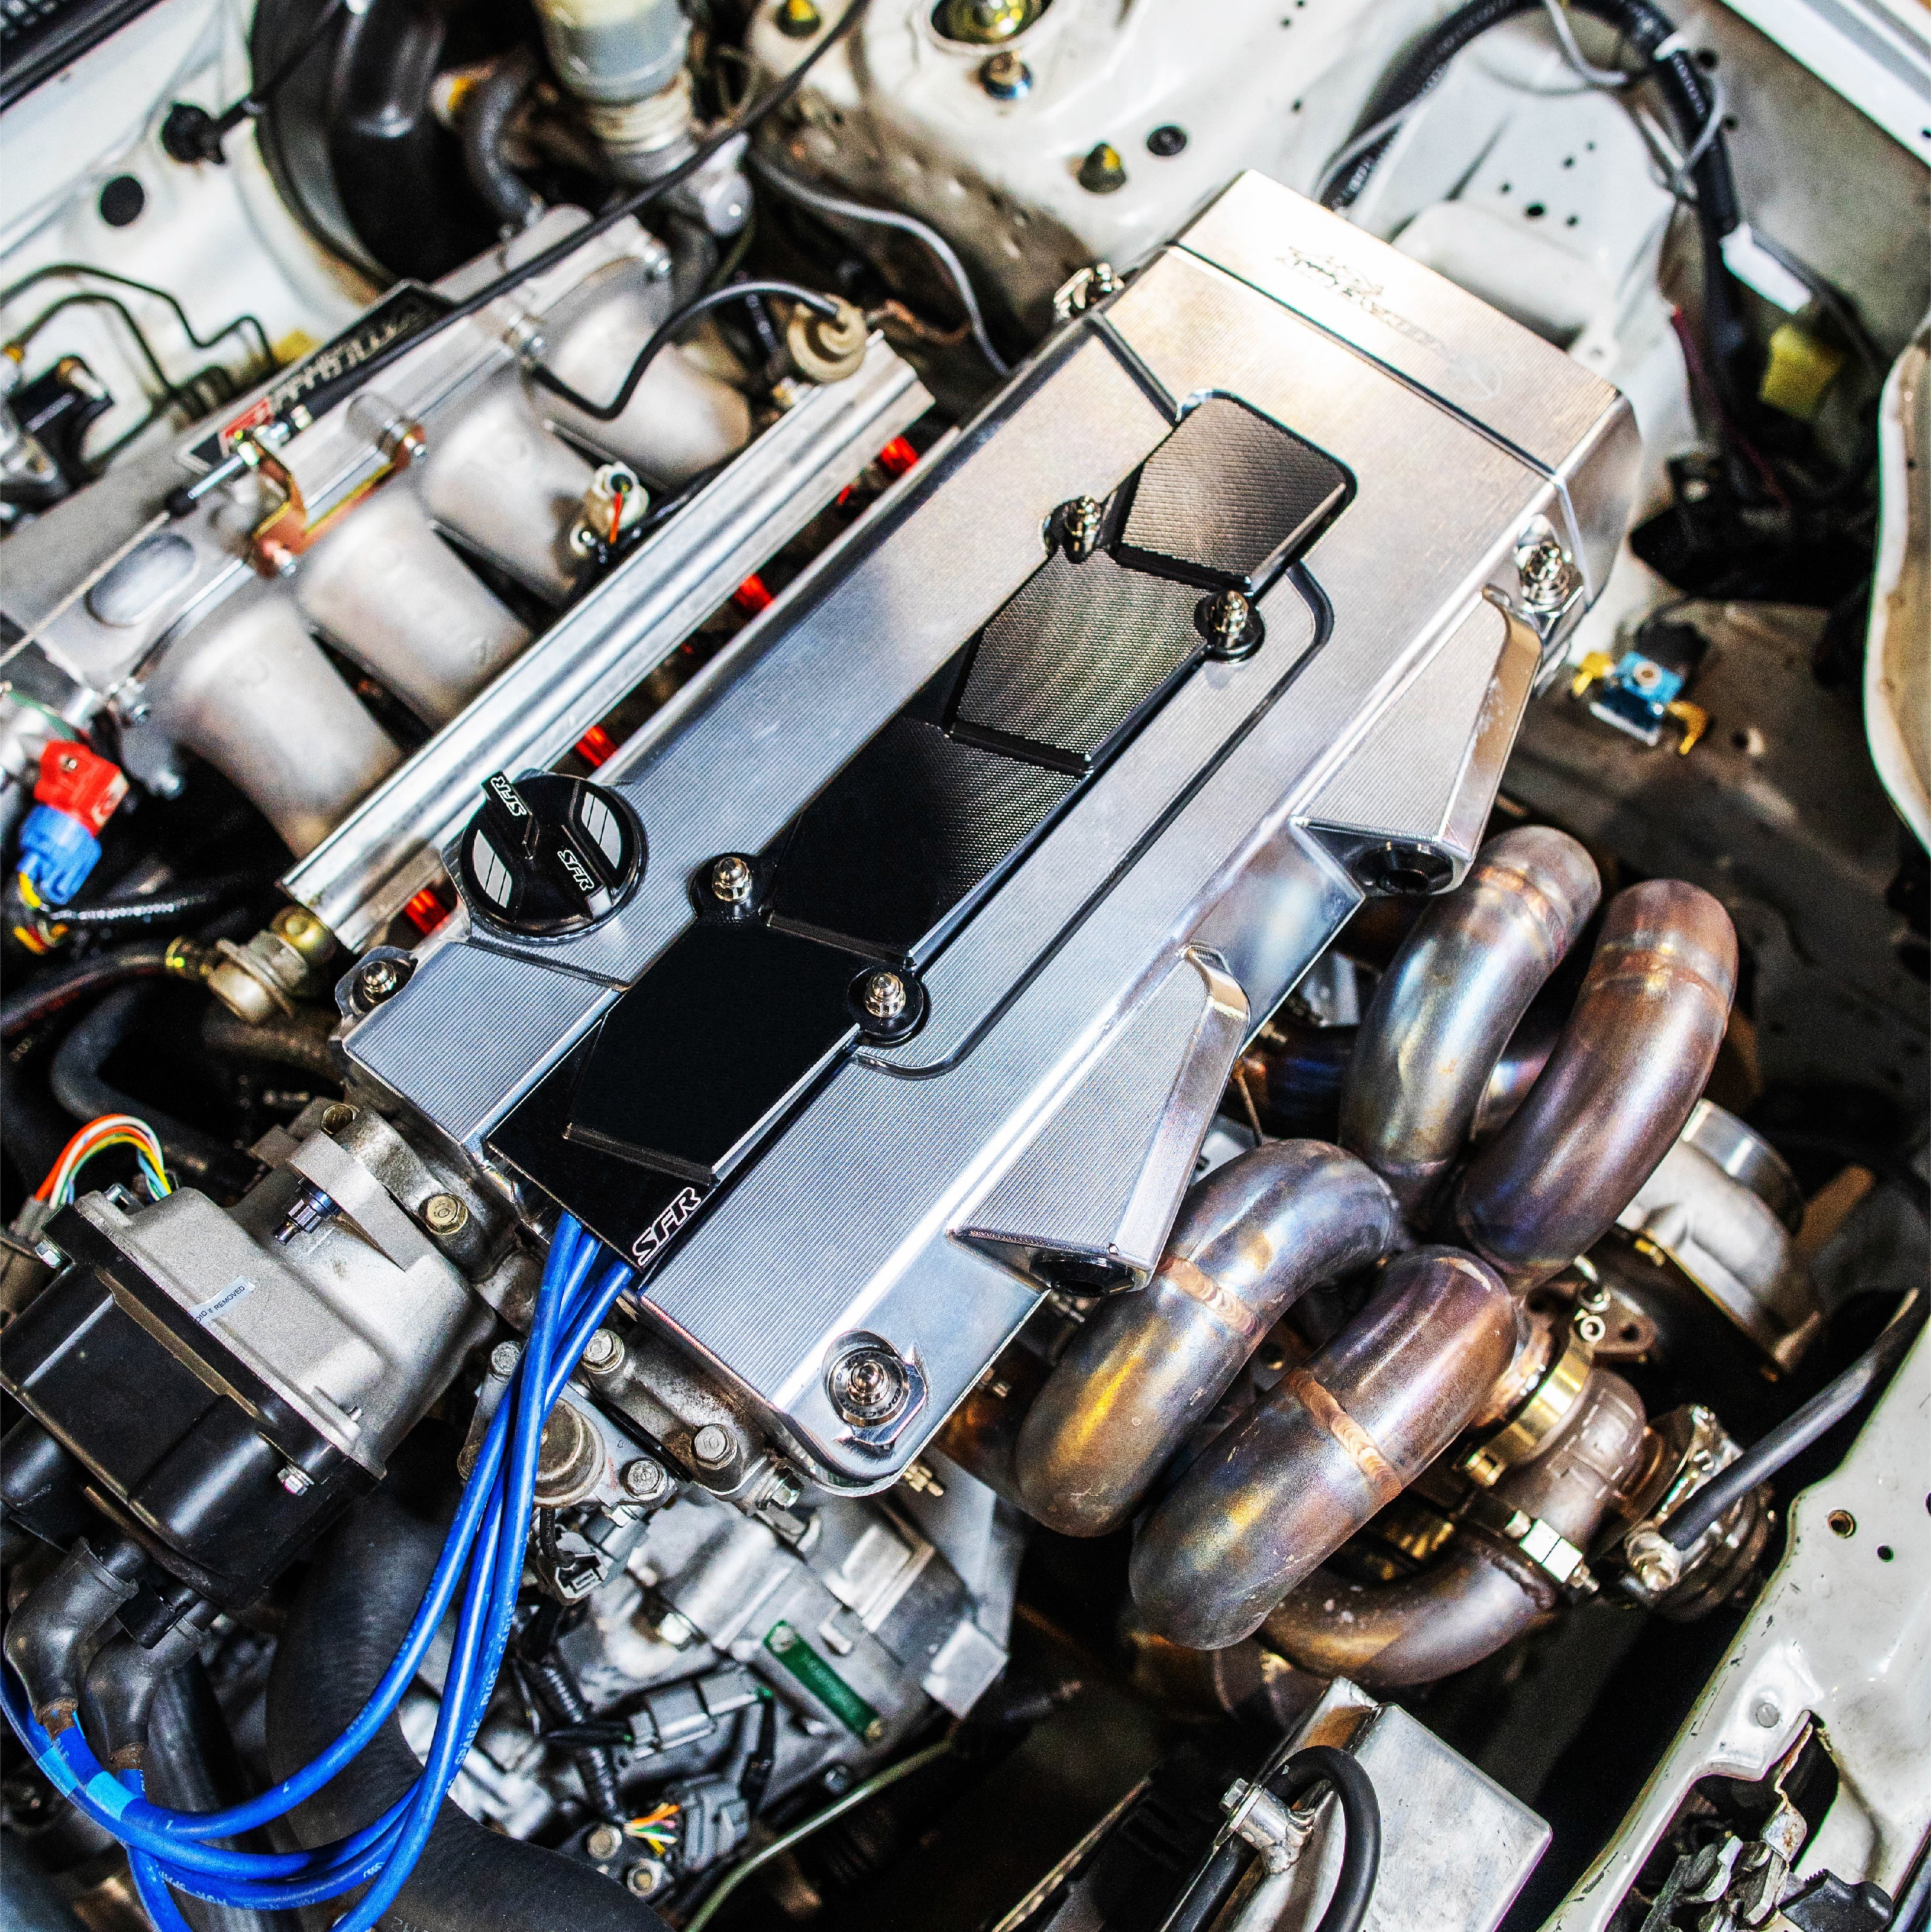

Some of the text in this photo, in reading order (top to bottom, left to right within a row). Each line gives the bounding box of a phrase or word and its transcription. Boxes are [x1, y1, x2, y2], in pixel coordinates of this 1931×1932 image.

[491, 776, 526, 816] SFR
[557, 849, 594, 891] SFR
[632, 1187, 701, 1266] SFR
[195, 1310, 208, 1323] OID
[214, 1286, 245, 1310] REMOVED
